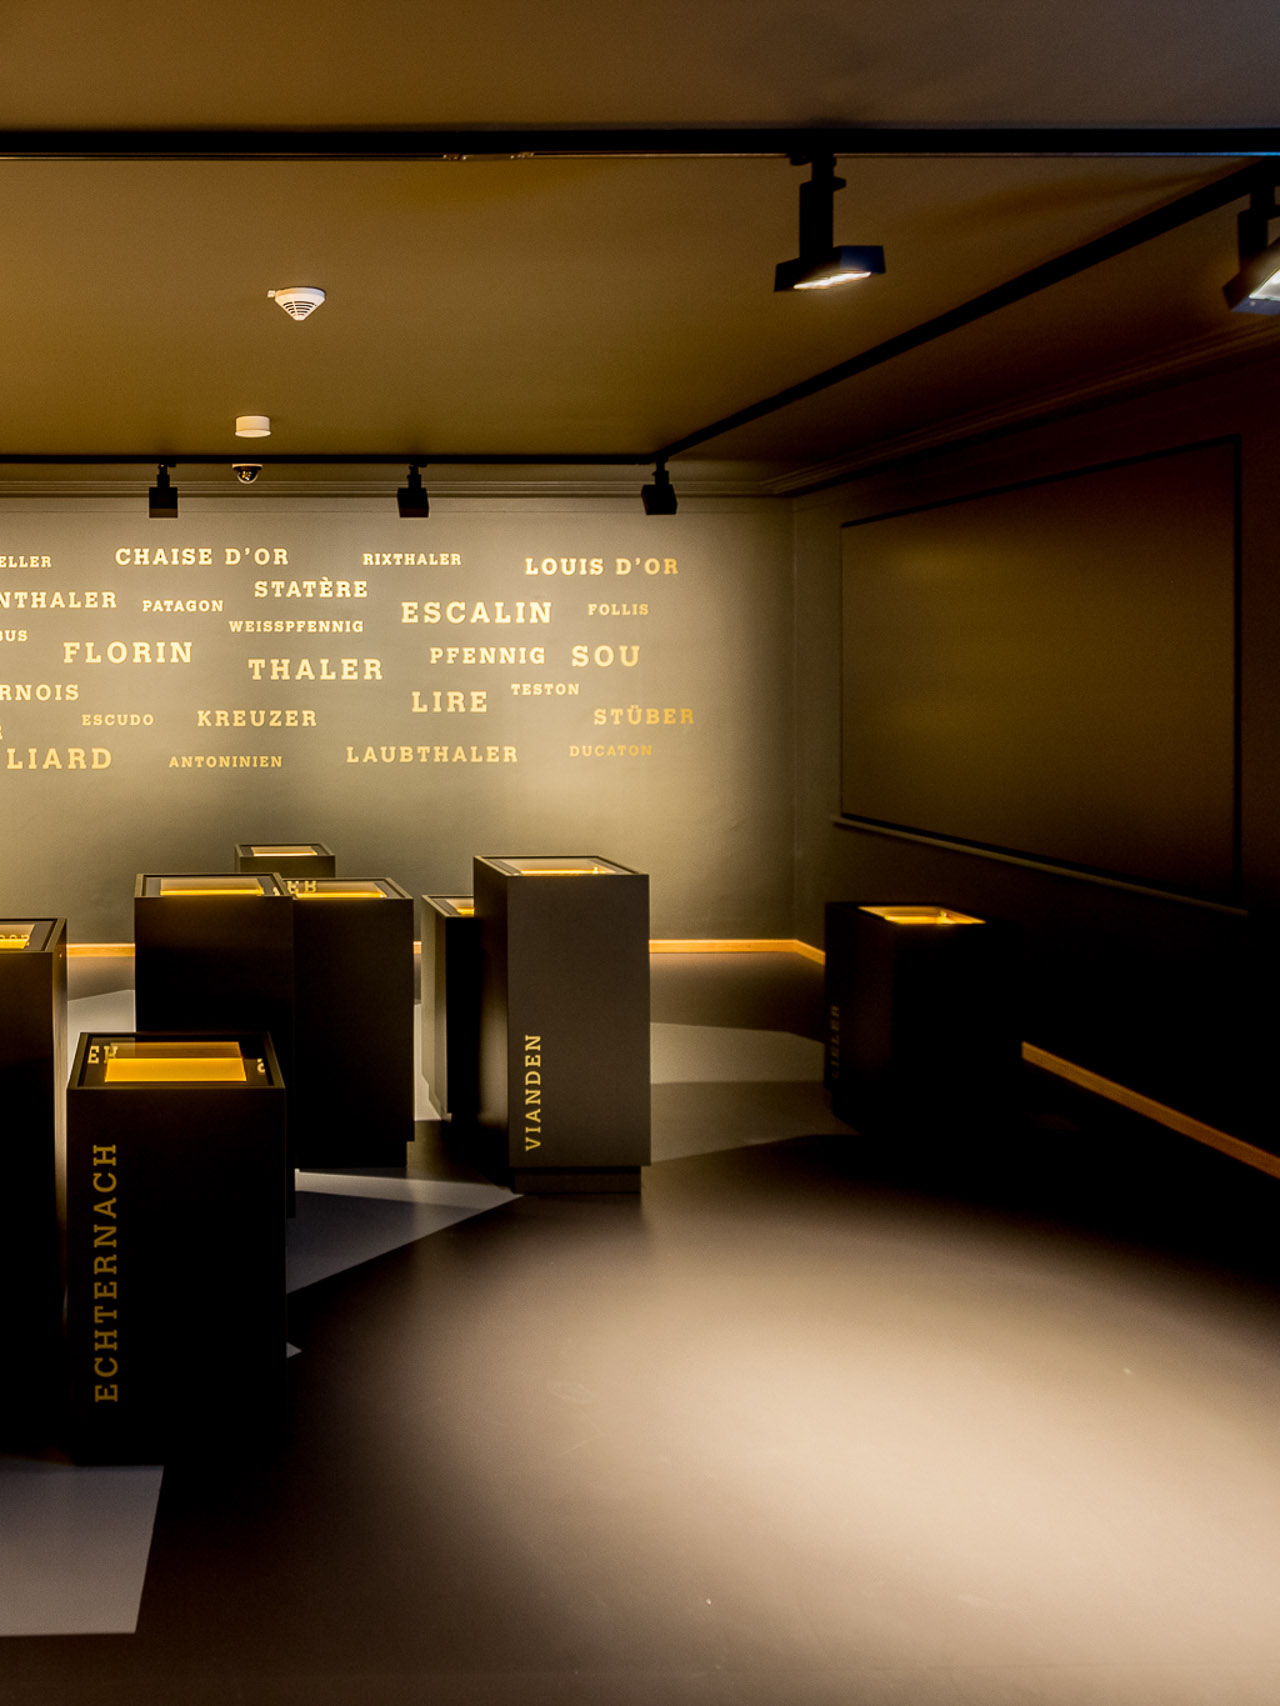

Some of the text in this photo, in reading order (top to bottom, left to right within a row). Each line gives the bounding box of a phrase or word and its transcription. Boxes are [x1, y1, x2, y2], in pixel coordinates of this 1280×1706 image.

[115, 547, 289, 566] CHAISE D'OR
[362, 553, 462, 566] RIXTHALER
[525, 557, 678, 576] LOUIS D'OR
[254, 576, 368, 598] STATÈRE
[142, 599, 223, 612] PATAGON
[401, 601, 552, 624] ESCALIN
[587, 603, 648, 616] FOLLIS
[228, 620, 364, 633] WEISSPFENNIG
[63, 641, 192, 664] FLORIN
[430, 646, 545, 665] PFENNIG
[571, 645, 640, 668] SOU
[248, 658, 383, 680] THALER
[510, 682, 580, 696] TESTON
[411, 690, 488, 713] LIRE
[82, 713, 154, 726] ESCUDO
[196, 709, 317, 727] KREUZER
[593, 704, 696, 726] STÜBER
[6, 747, 112, 770] LIARD
[346, 745, 520, 764] LAUBTHALER
[568, 744, 653, 757] DUCATON
[168, 755, 283, 768] ANTONINIEN
[524, 1034, 542, 1151] VIANDEN
[92, 1144, 119, 1403] ECHTERNACH
